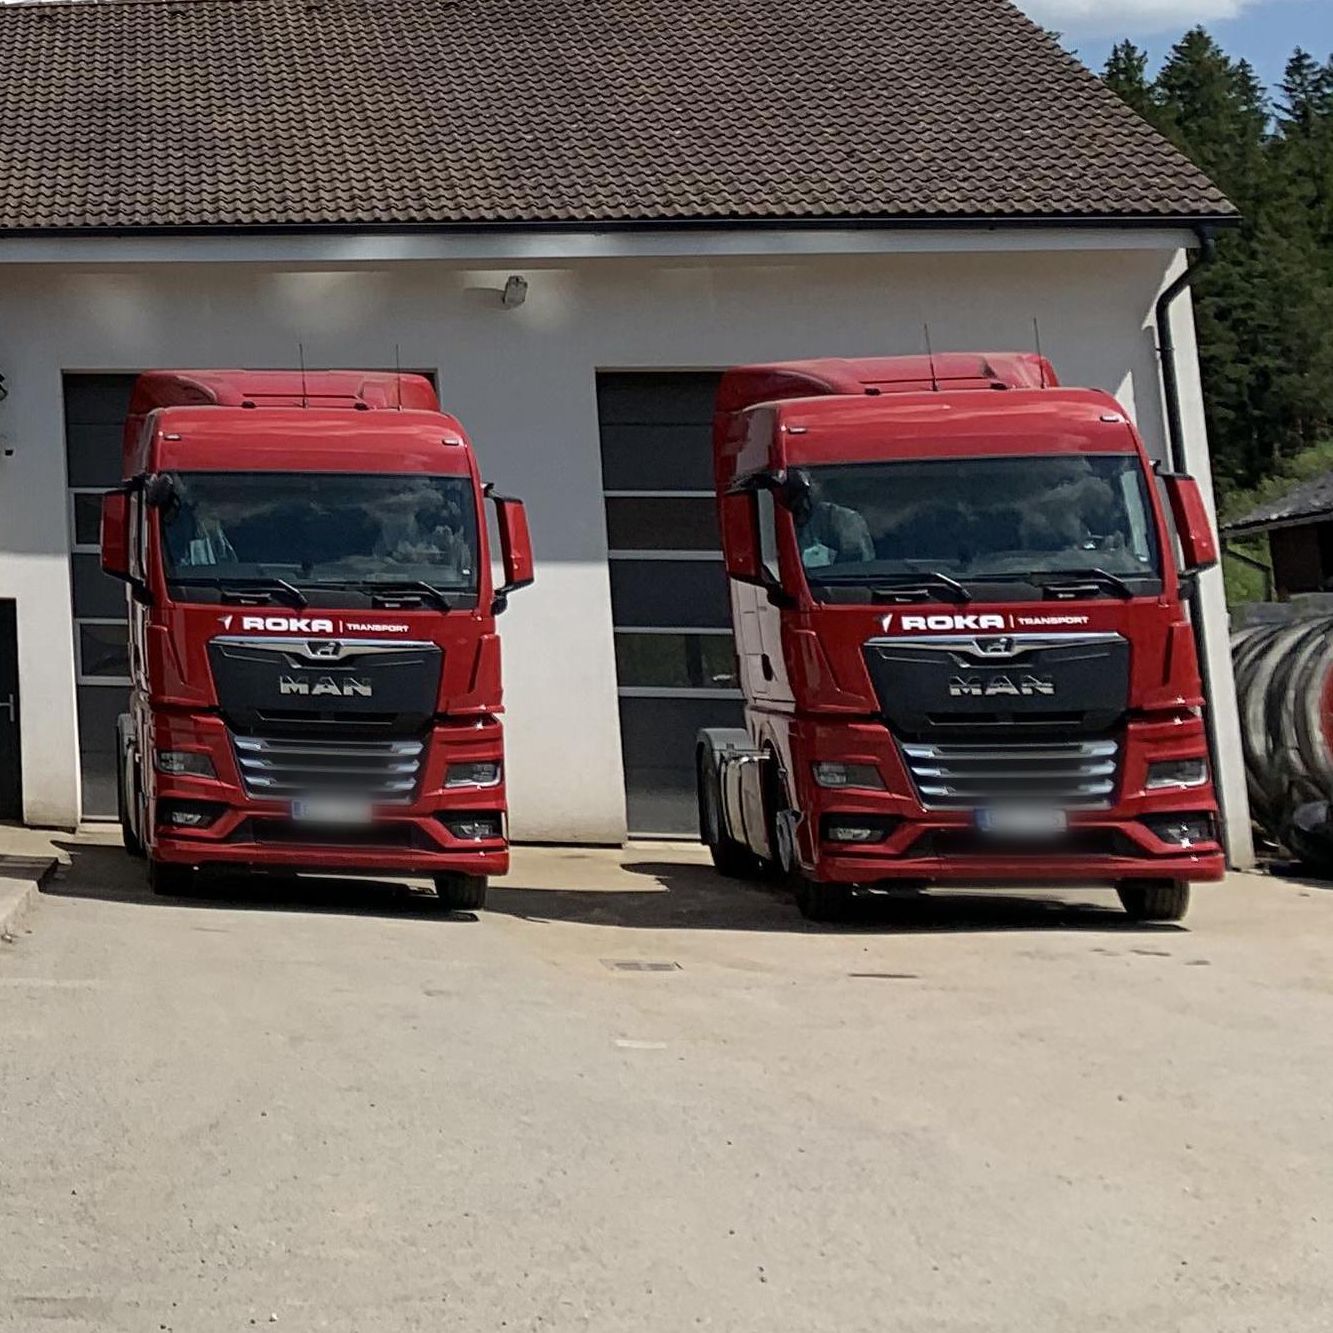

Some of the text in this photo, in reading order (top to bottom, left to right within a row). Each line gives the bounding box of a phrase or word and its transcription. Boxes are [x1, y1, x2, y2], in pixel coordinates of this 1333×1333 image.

[242, 616, 409, 633] ROKA TRANSPORT
[900, 615, 1089, 630] ROKA TRANSPORT
[279, 675, 372, 696] MAN
[948, 675, 1055, 696] MAN
